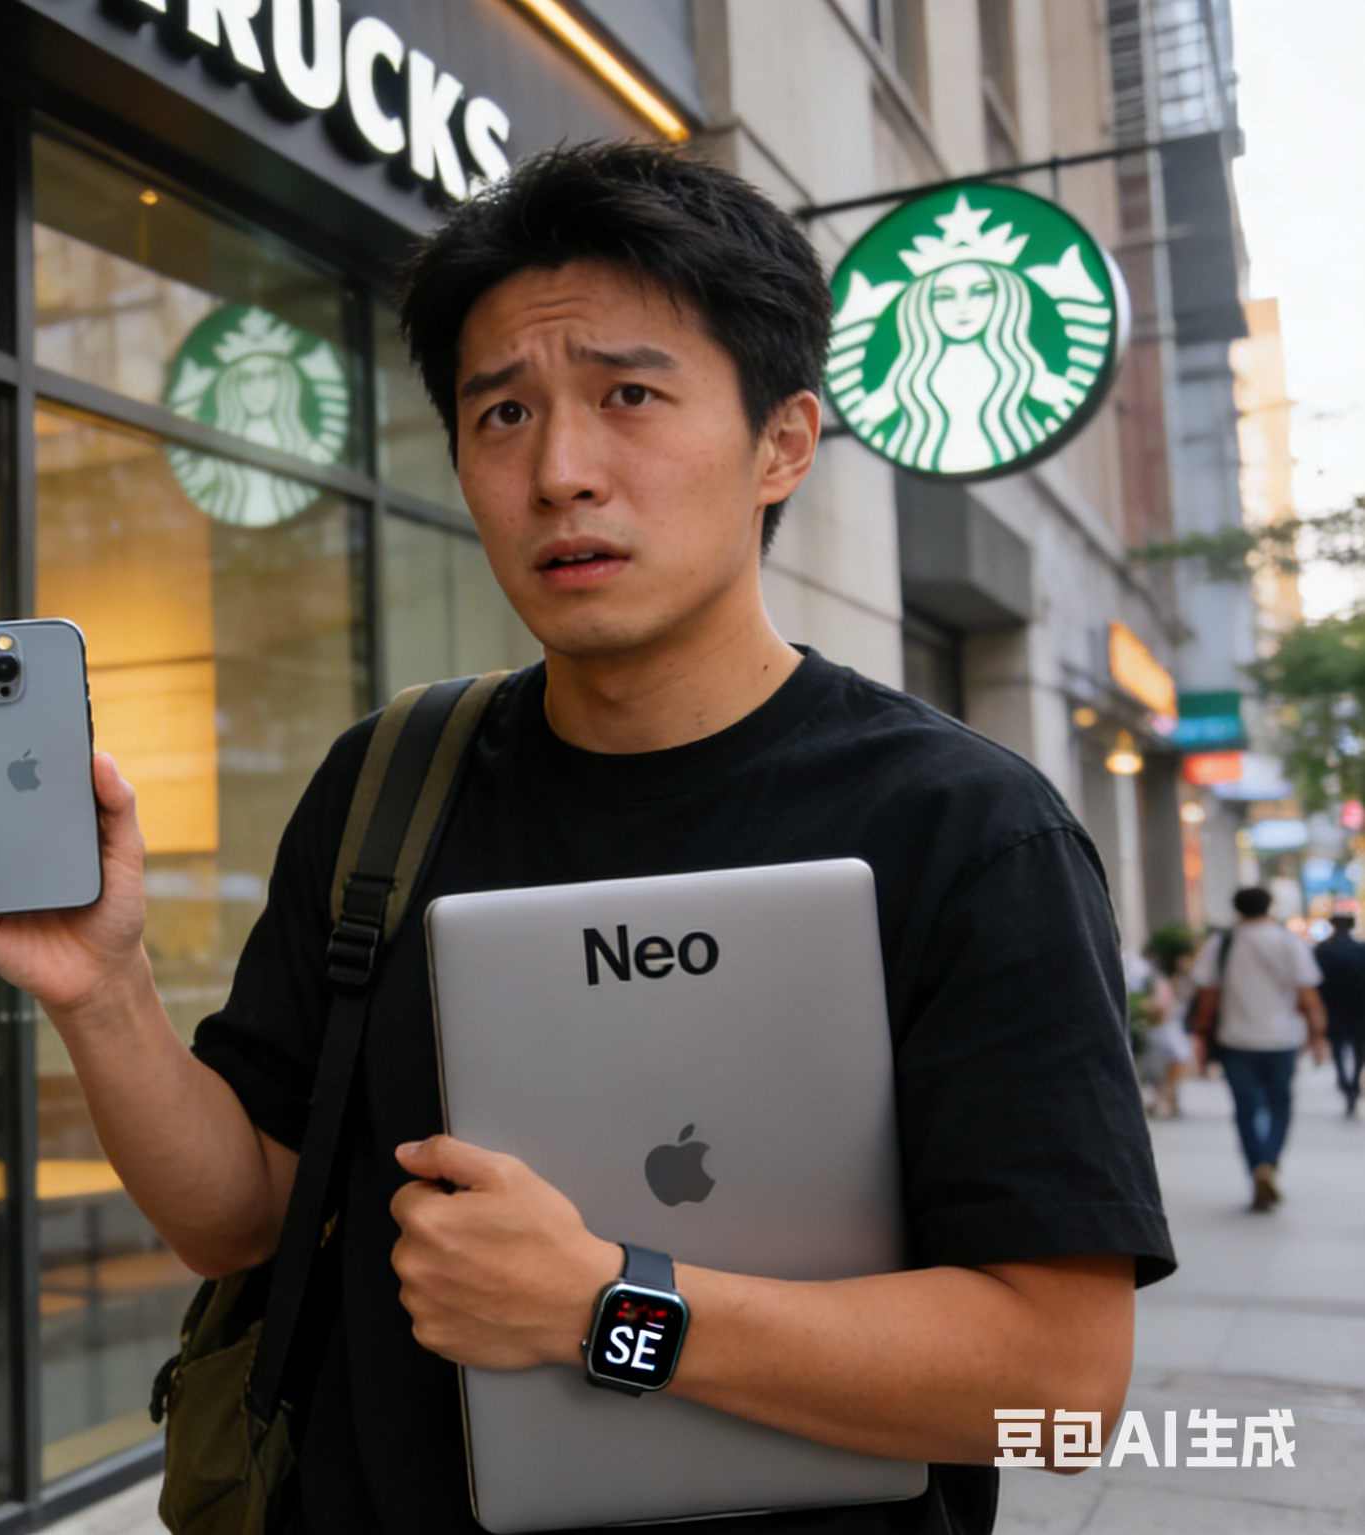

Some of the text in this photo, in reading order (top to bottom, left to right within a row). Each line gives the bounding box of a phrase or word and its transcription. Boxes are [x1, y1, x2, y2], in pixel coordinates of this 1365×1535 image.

[141, 0, 511, 202] RUCKS
[583, 924, 719, 986] Neo
[605, 1325, 663, 1371] SE
